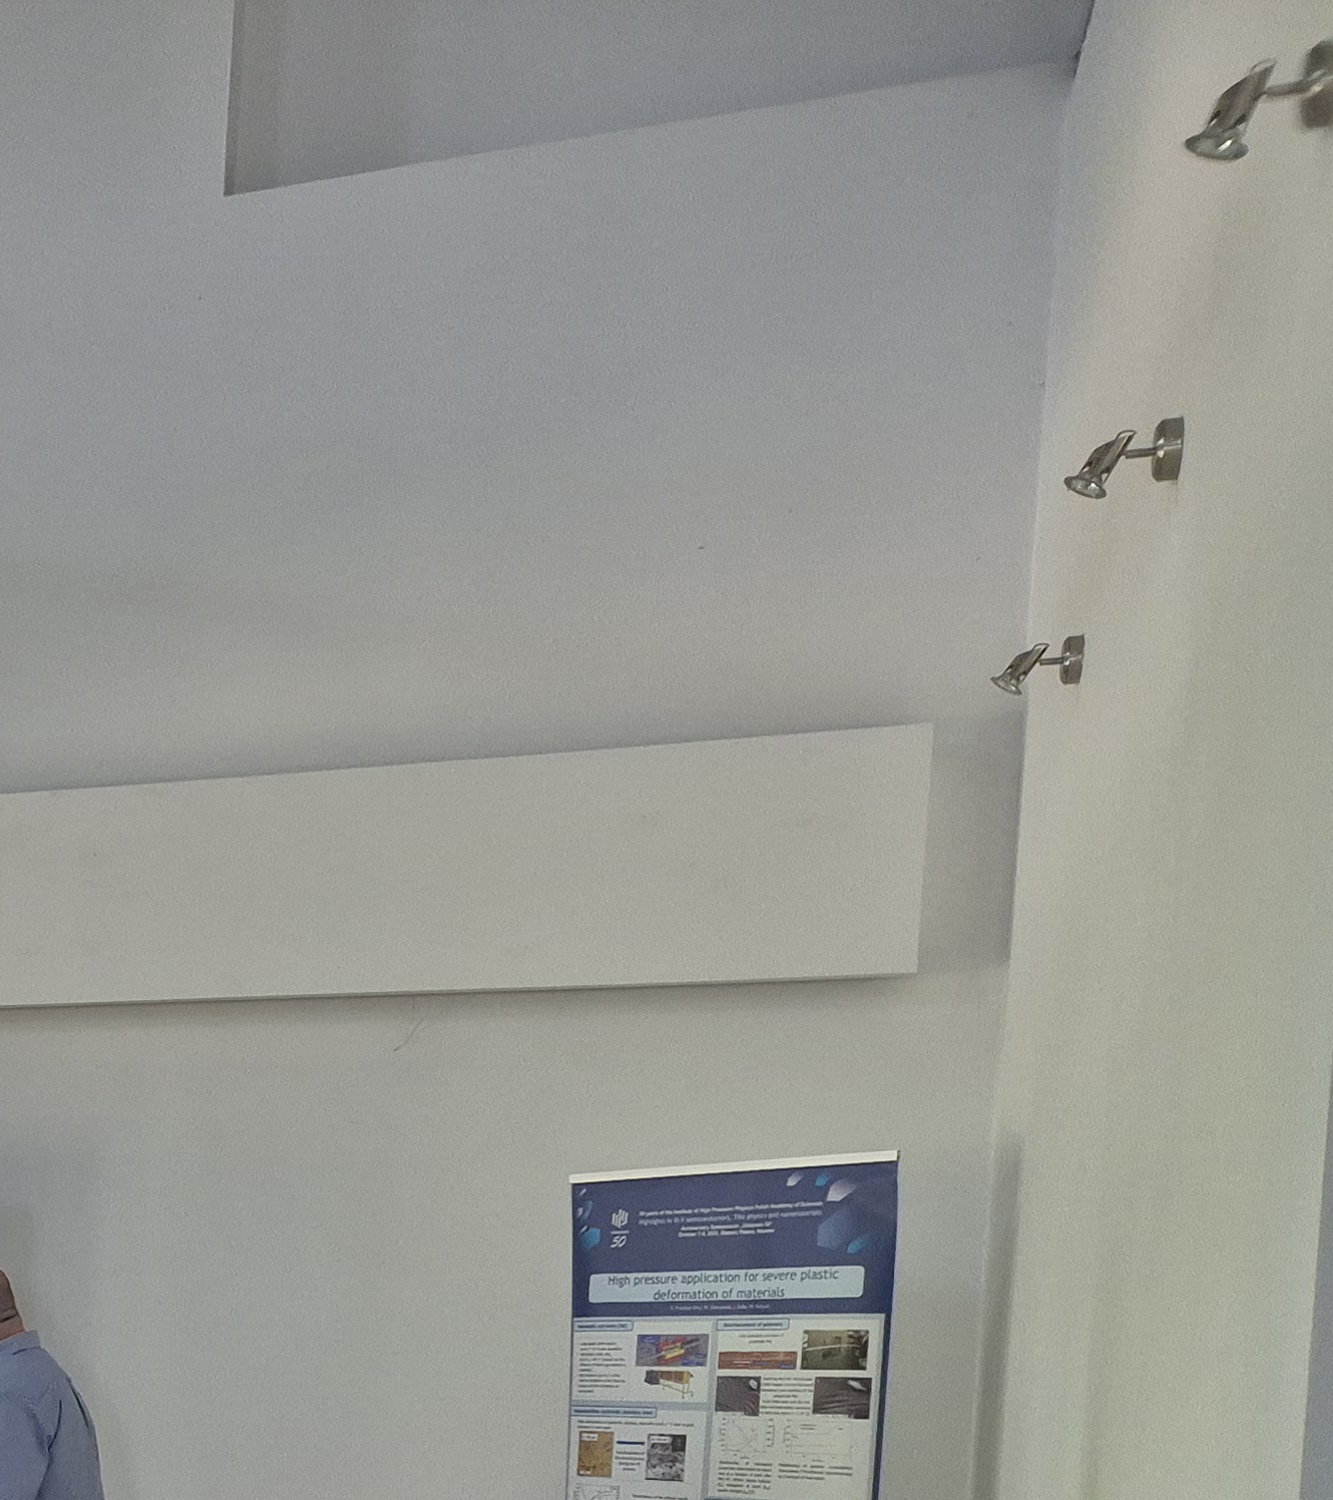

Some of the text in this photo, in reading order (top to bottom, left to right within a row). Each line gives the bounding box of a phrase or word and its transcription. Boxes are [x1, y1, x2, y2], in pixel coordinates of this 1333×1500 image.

[608, 1268, 840, 1288] High pressure application for severe plastic
[653, 1286, 785, 1301] deformation of materials
